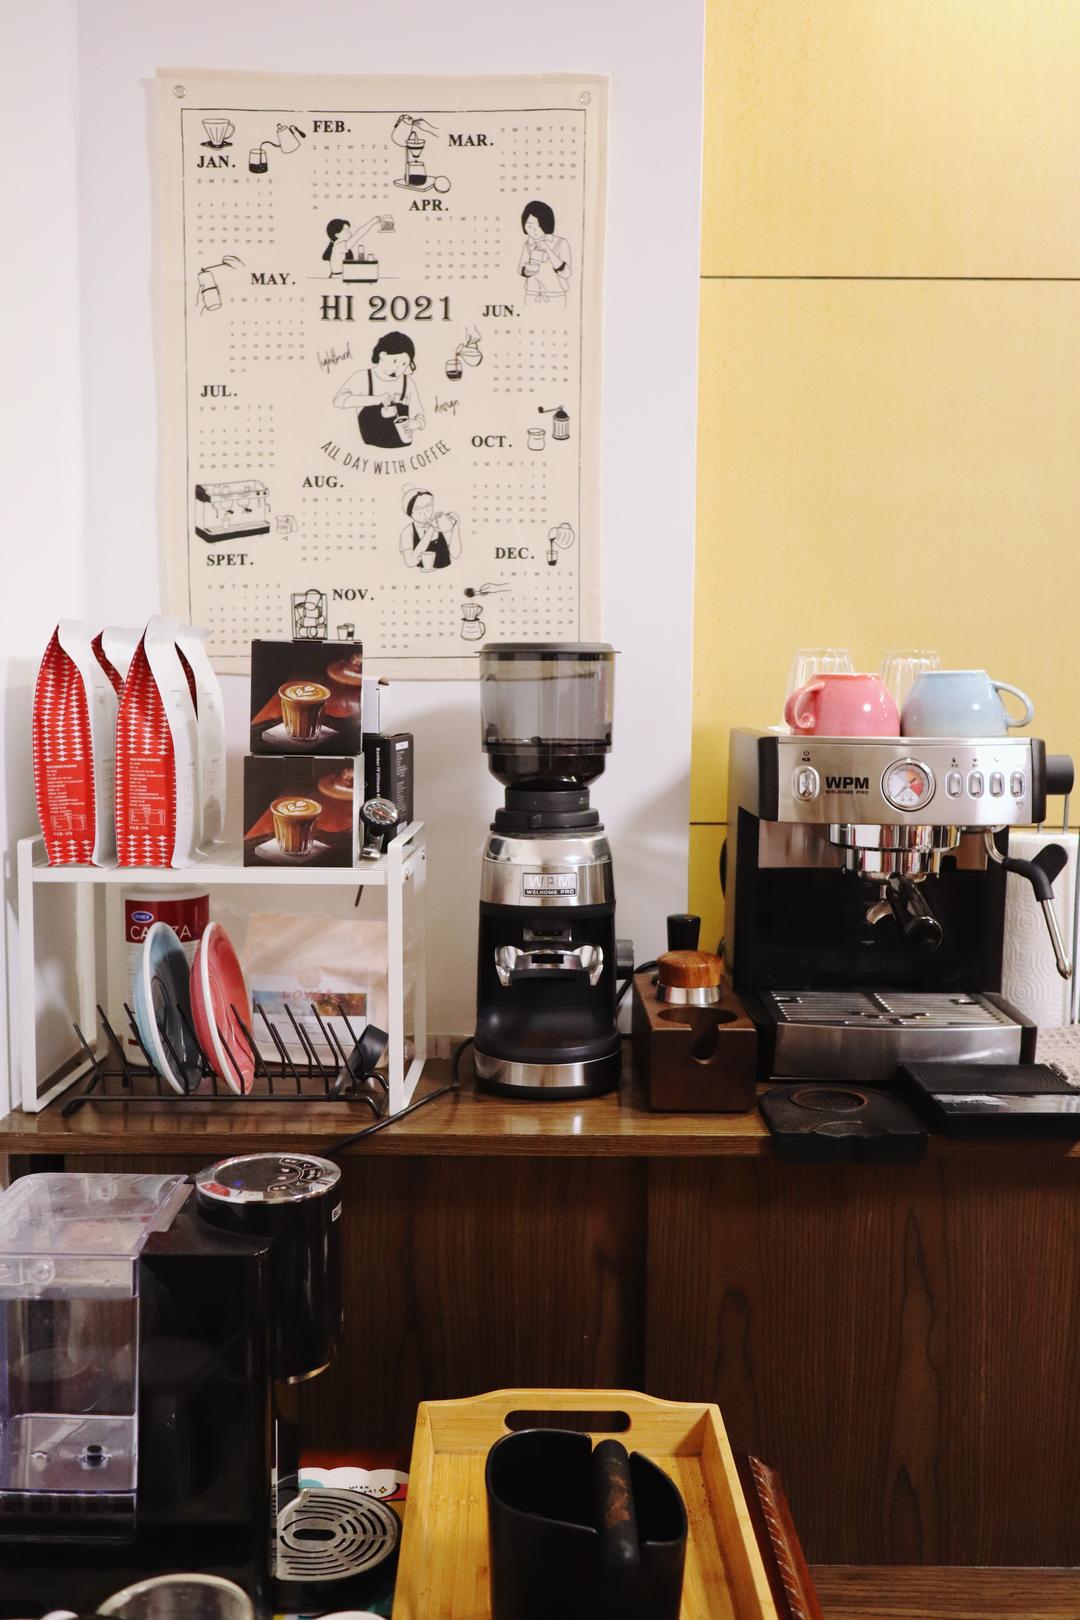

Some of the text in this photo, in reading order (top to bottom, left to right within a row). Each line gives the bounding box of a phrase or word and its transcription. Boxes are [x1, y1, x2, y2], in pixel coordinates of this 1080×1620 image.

[313, 120, 351, 133] FEB.
[449, 134, 494, 147] MAR.
[197, 156, 236, 169] JAN.
[409, 199, 449, 212] APR.
[251, 273, 296, 286] MAY.
[320, 295, 452, 322] HI 2021
[483, 305, 521, 318] JUN.
[201, 385, 238, 398] JUL.
[472, 436, 513, 448] OCT.
[320, 440, 451, 475] ALL DAY WITH COFFEE
[303, 476, 344, 489] AUG.
[496, 547, 535, 560] DEC.
[207, 554, 254, 567] SPET.
[333, 589, 375, 601] NOV.
[825, 776, 869, 789] WPM
[529, 876, 571, 888] WPM
